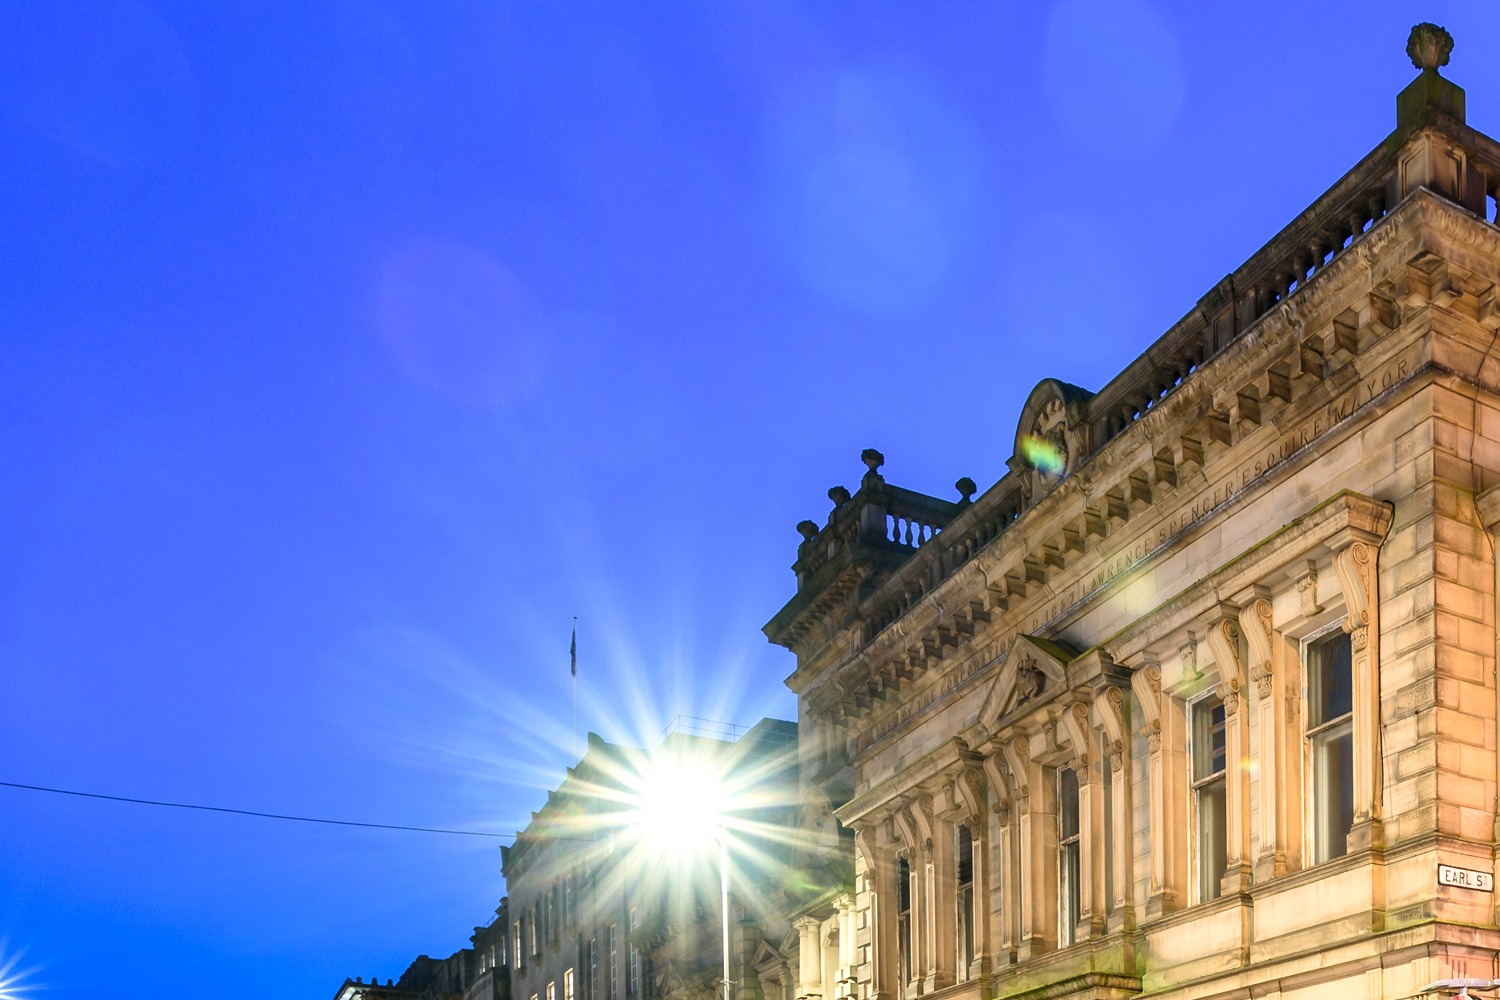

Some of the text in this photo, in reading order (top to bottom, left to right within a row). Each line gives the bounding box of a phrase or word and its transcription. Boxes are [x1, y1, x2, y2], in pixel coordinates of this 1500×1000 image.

[1081, 538, 1150, 594] LAWRENCE
[1159, 480, 1234, 544] SPENCER
[1241, 421, 1324, 488] ESQUIRE
[1445, 869, 1472, 885] EARL
